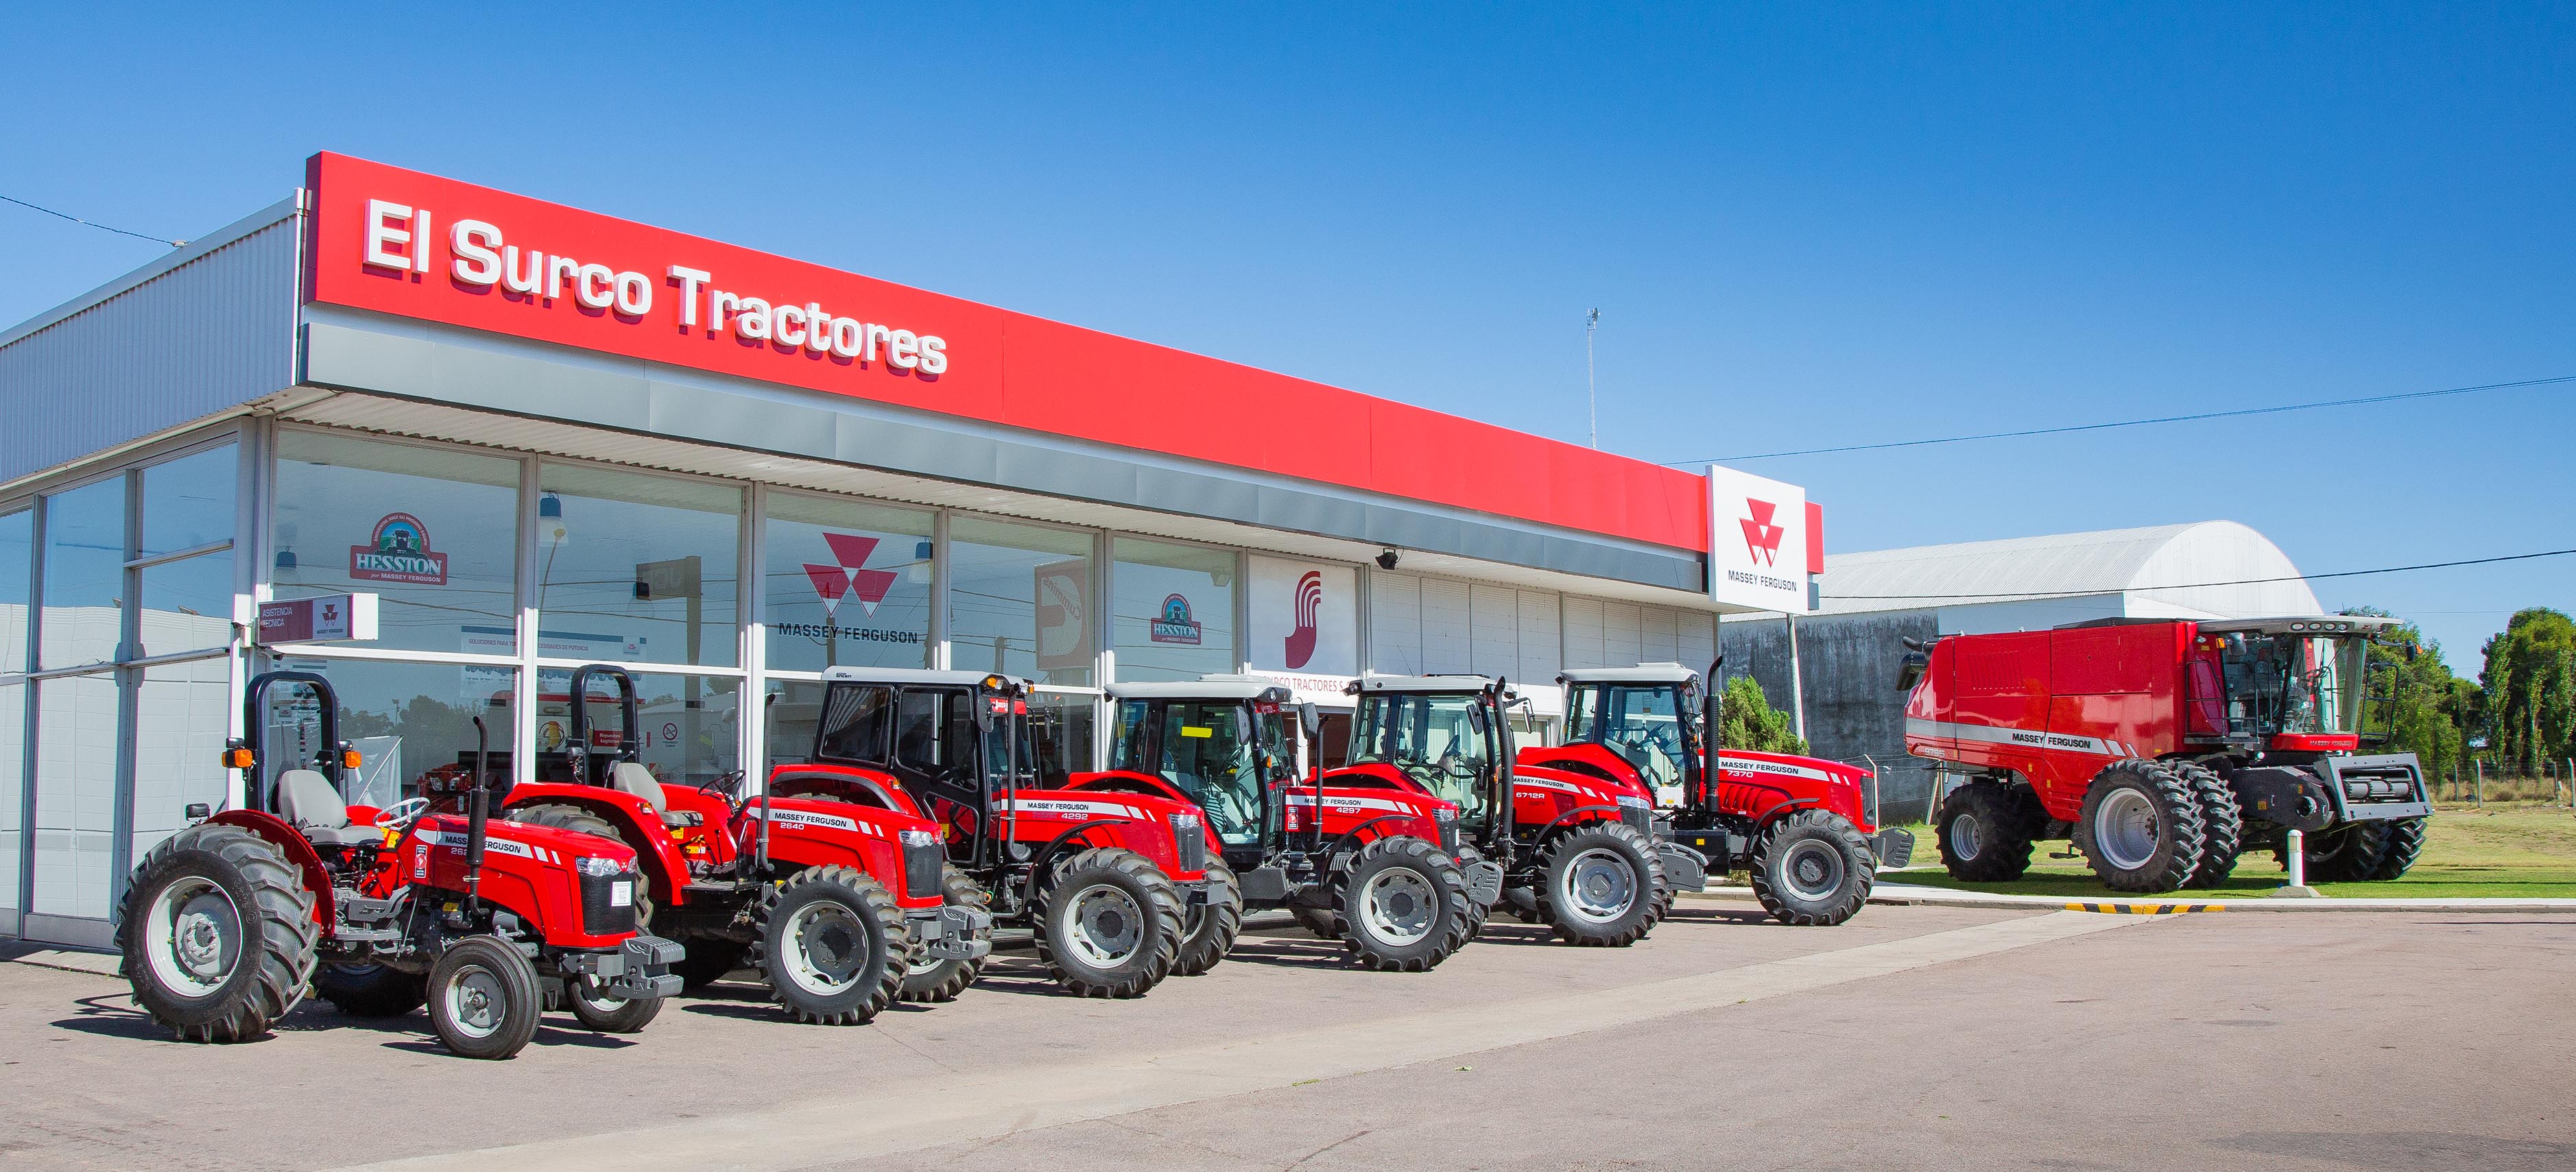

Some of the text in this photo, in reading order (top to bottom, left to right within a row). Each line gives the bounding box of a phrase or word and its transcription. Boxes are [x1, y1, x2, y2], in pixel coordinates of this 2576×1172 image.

[363, 198, 948, 375] El Surco Tractores
[356, 553, 442, 575] HESSTON
[408, 574, 441, 582] FERGUSON
[1728, 570, 1797, 592] MASSEY FERGUSON
[263, 606, 293, 617] ASISTENCIA
[779, 622, 918, 644] MASSEY FERGUSON
[1153, 623, 1198, 638] HESSTON
[1292, 678, 1337, 692] TRACTORES
[2012, 733, 2090, 749] MASSEY FERGUSON
[1924, 748, 1945, 758] 9795
[1721, 761, 1798, 774] MASSEY FERGUSON
[1727, 769, 1753, 778] 7370
[1536, 780, 1564, 788] FERGUSON
[774, 812, 847, 827] MASSEY FERGUSON
[780, 822, 804, 830] 2640
[445, 835, 521, 854] MASS ERGUSON
[451, 847, 468, 856] 262
